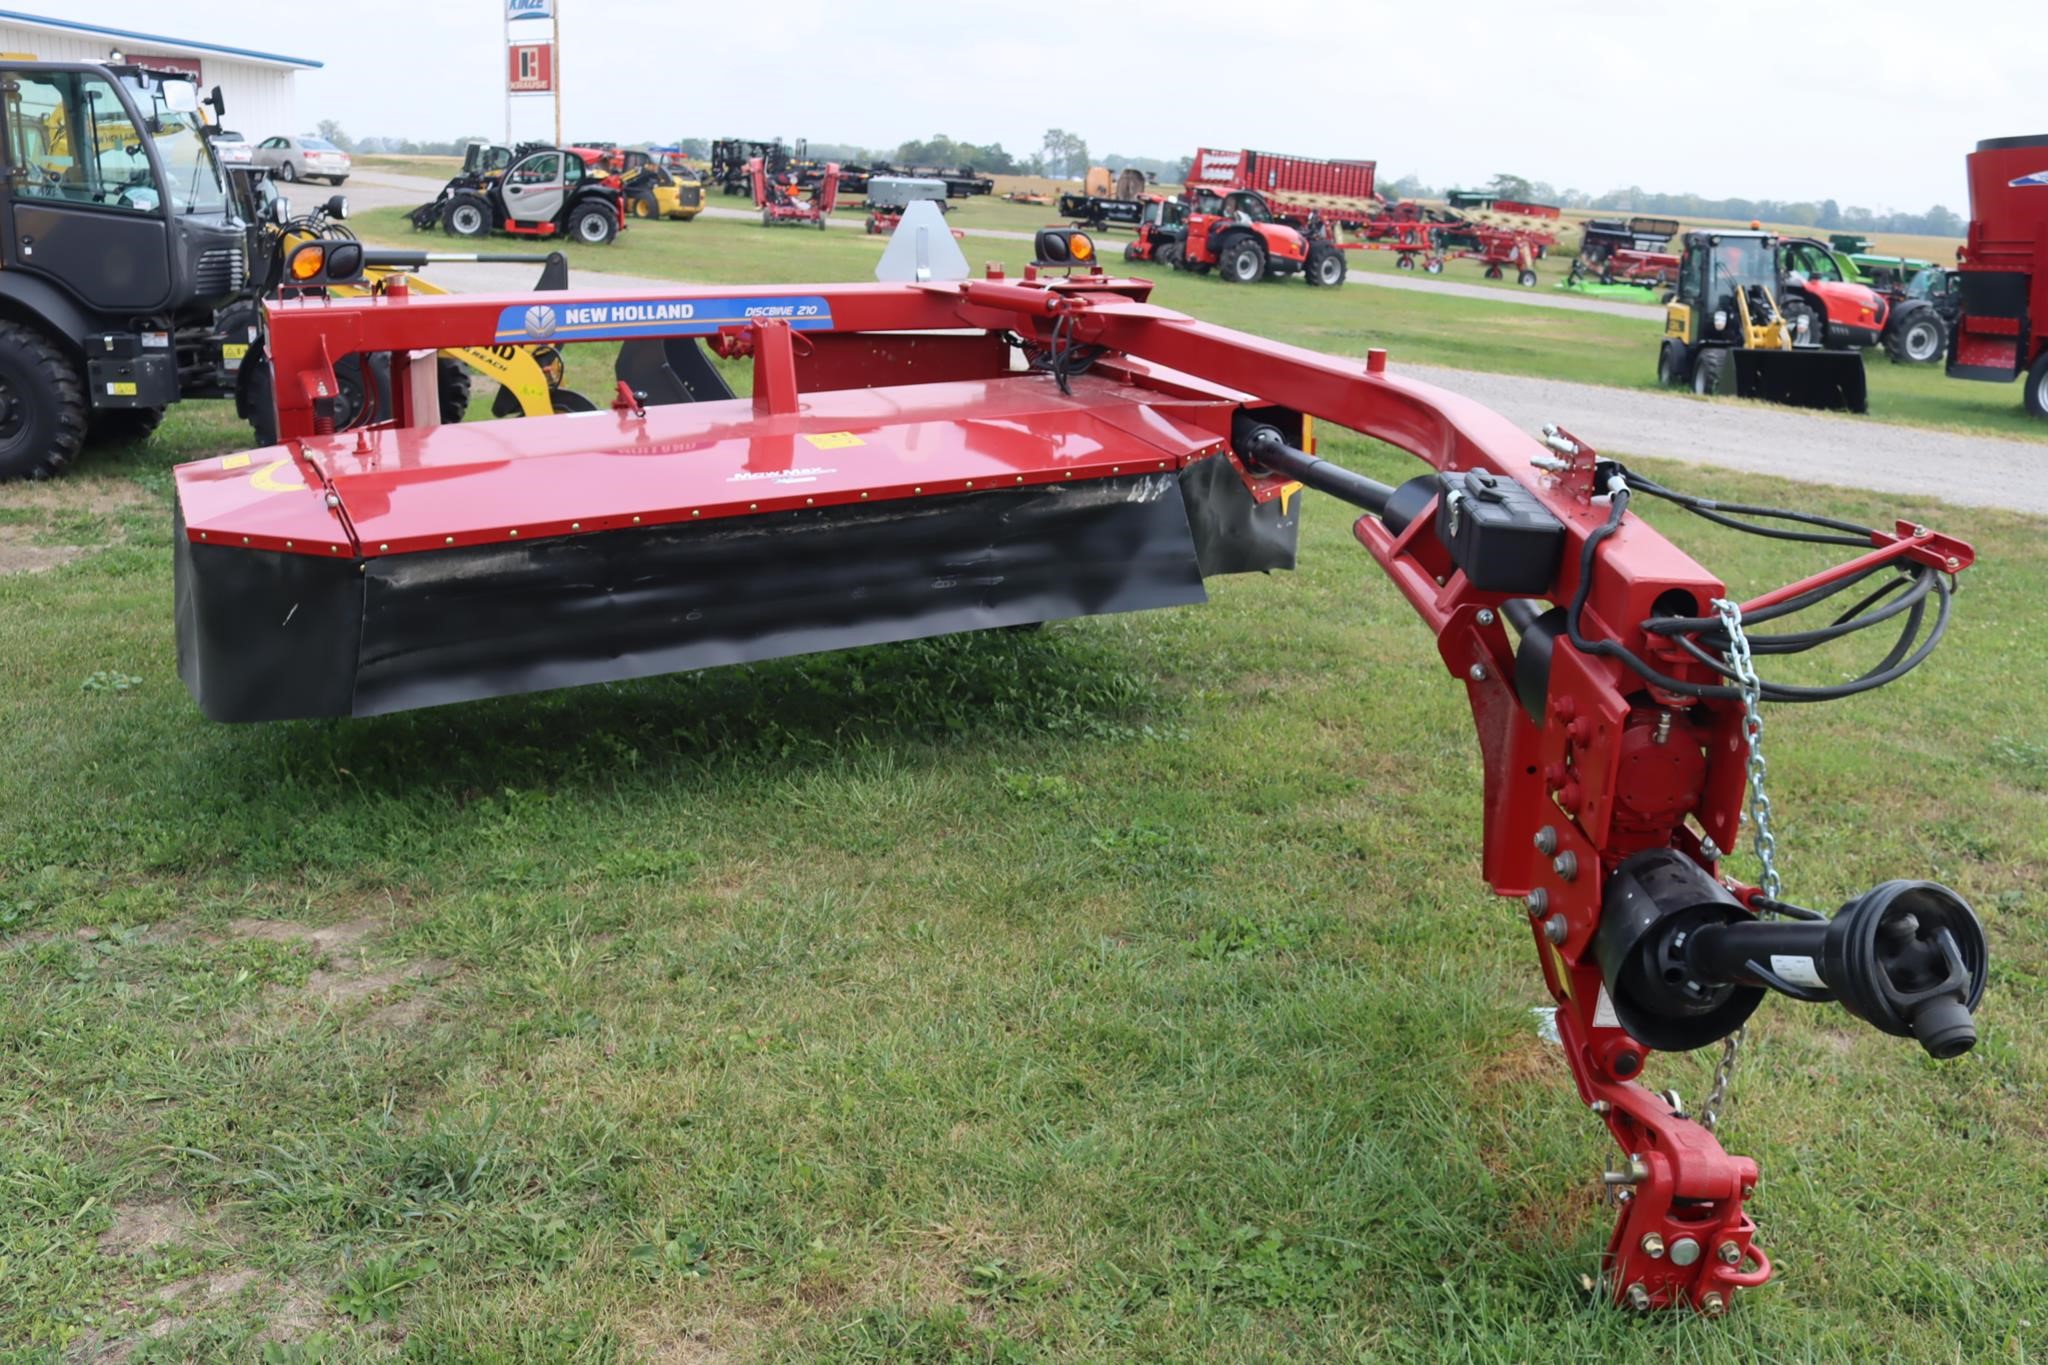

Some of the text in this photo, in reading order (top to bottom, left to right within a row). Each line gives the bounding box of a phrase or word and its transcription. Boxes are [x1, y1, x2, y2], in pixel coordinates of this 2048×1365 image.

[511, 80, 547, 90] KRAUSE
[565, 304, 694, 324] NEW HOLLAND
[745, 305, 817, 317] DISCBINE 210
